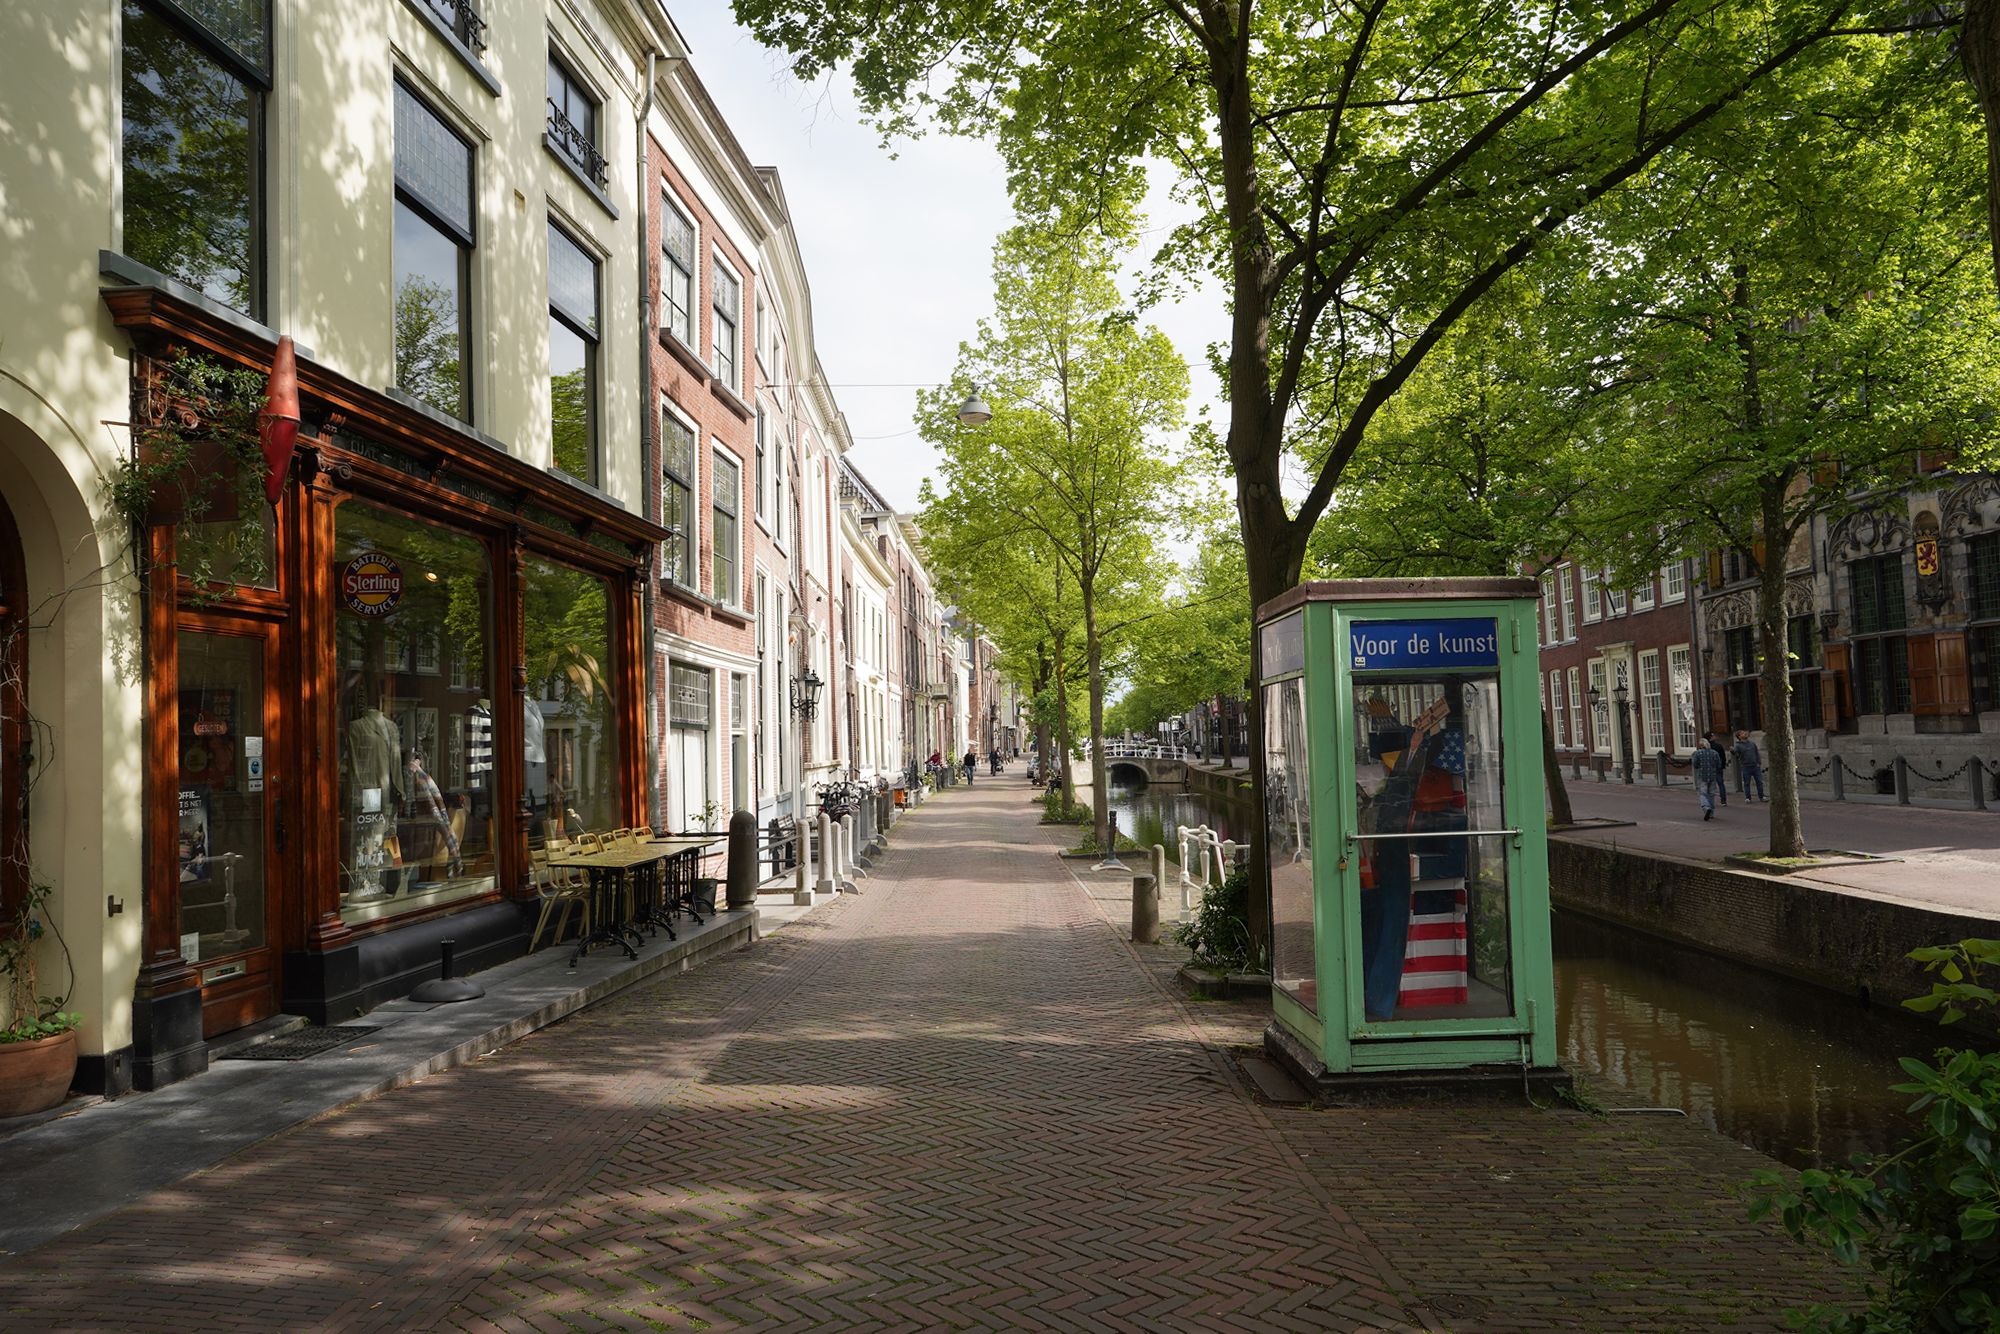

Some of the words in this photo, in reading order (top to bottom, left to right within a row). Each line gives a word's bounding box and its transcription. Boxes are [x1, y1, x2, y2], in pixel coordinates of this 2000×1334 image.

[351, 553, 397, 571] BATTERIE
[346, 574, 400, 594] Sterling
[351, 597, 396, 615] SERVICE
[1352, 634, 1398, 656] Voor
[1407, 633, 1431, 655] de
[1439, 632, 1496, 654] kunst
[356, 813, 386, 825] OSKA
